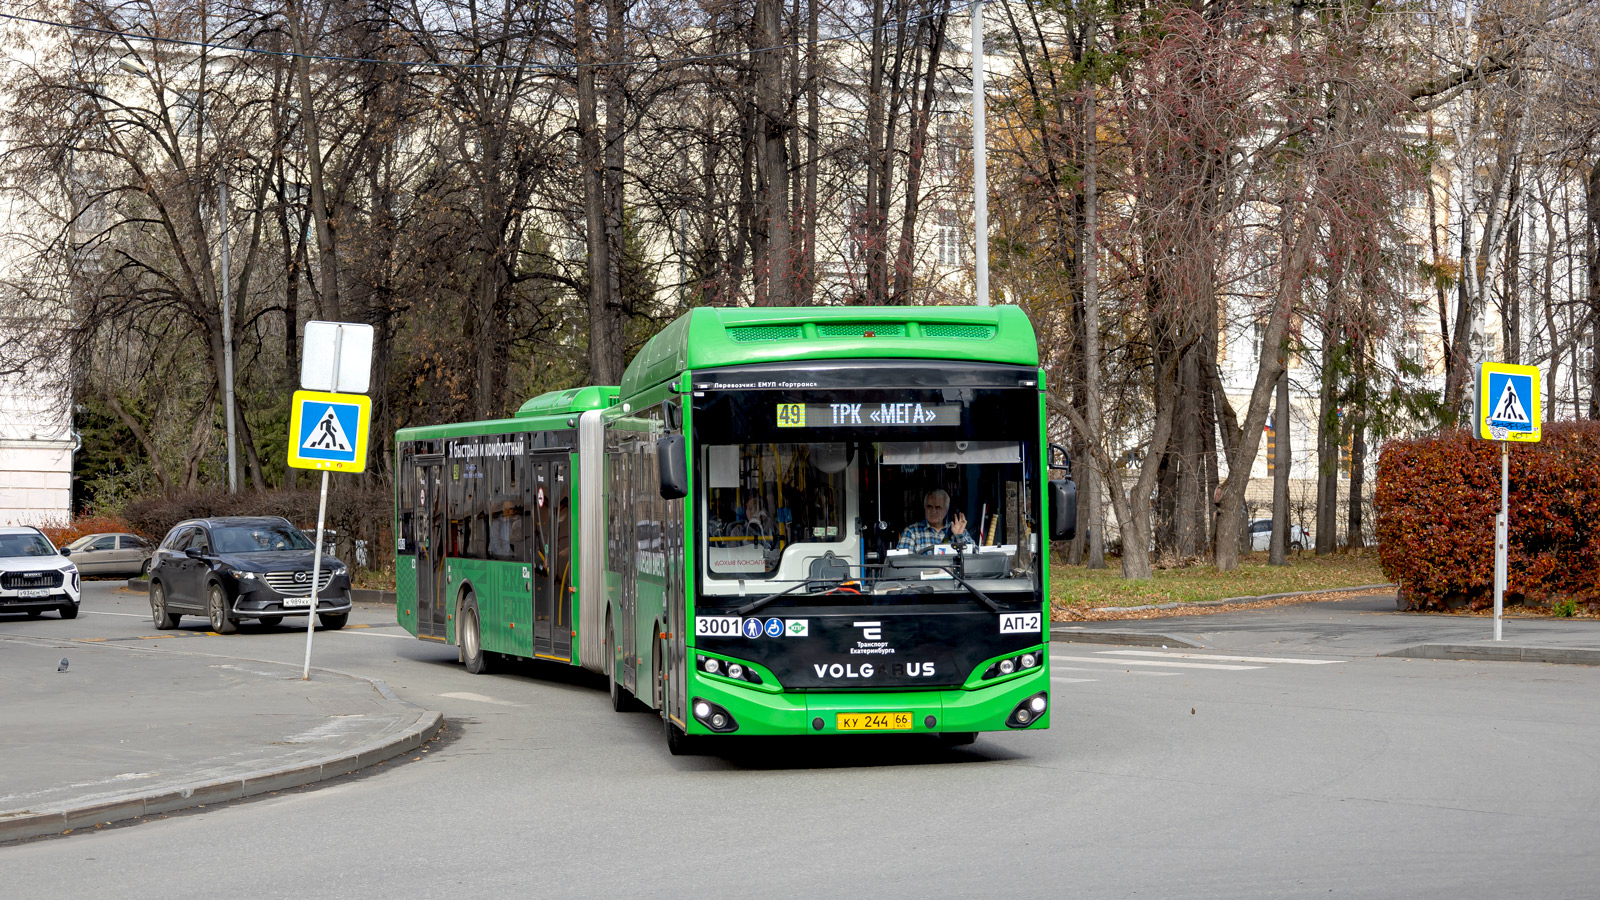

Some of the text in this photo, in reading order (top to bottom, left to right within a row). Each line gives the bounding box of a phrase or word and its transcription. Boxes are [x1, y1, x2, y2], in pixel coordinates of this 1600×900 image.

[780, 404, 801, 424] 49
[830, 403, 937, 424] ТРК «МЕГА»
[453, 439, 479, 462] быстрый
[480, 443, 484, 457] и
[484, 436, 524, 462] комфортный
[699, 619, 739, 635] 3001
[1003, 616, 1038, 630] АП-2
[864, 715, 888, 728] 244
[895, 714, 908, 724] 66
